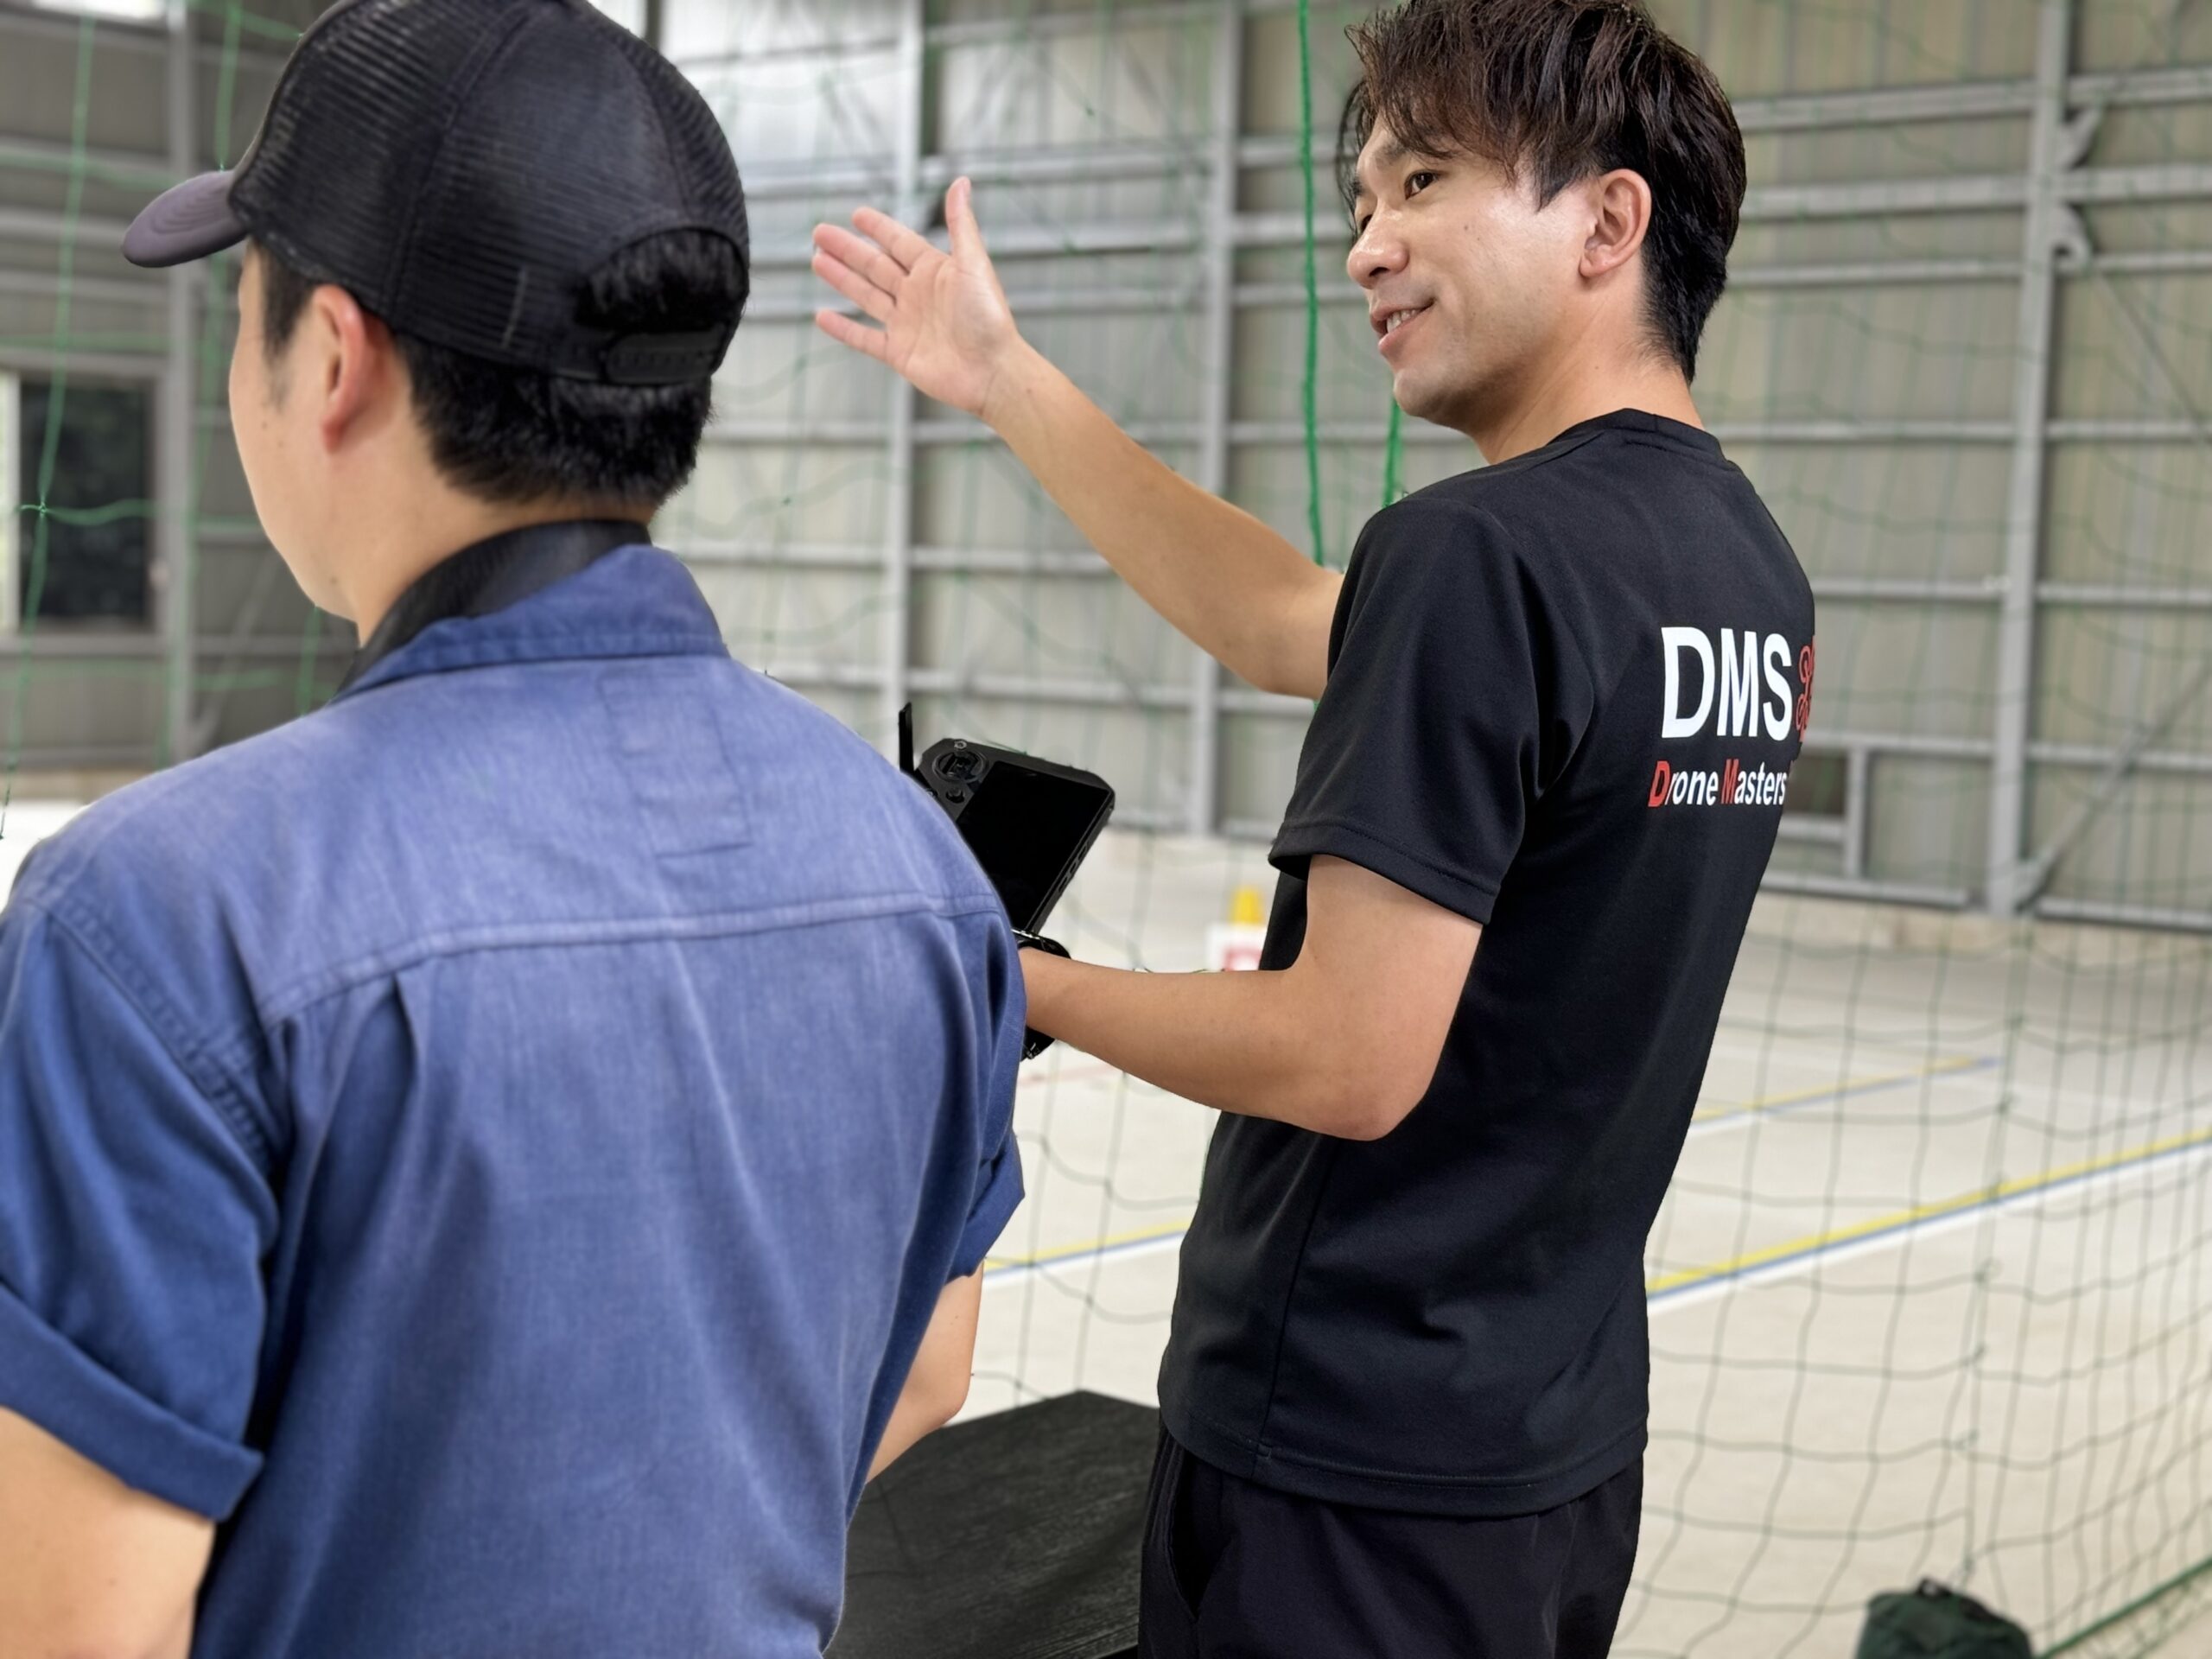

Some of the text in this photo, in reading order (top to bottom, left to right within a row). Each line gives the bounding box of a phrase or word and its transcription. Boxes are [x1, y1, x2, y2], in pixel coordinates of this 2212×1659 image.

[1661, 626, 1793, 741] DMS
[1648, 759, 1788, 807] Drone Masters
